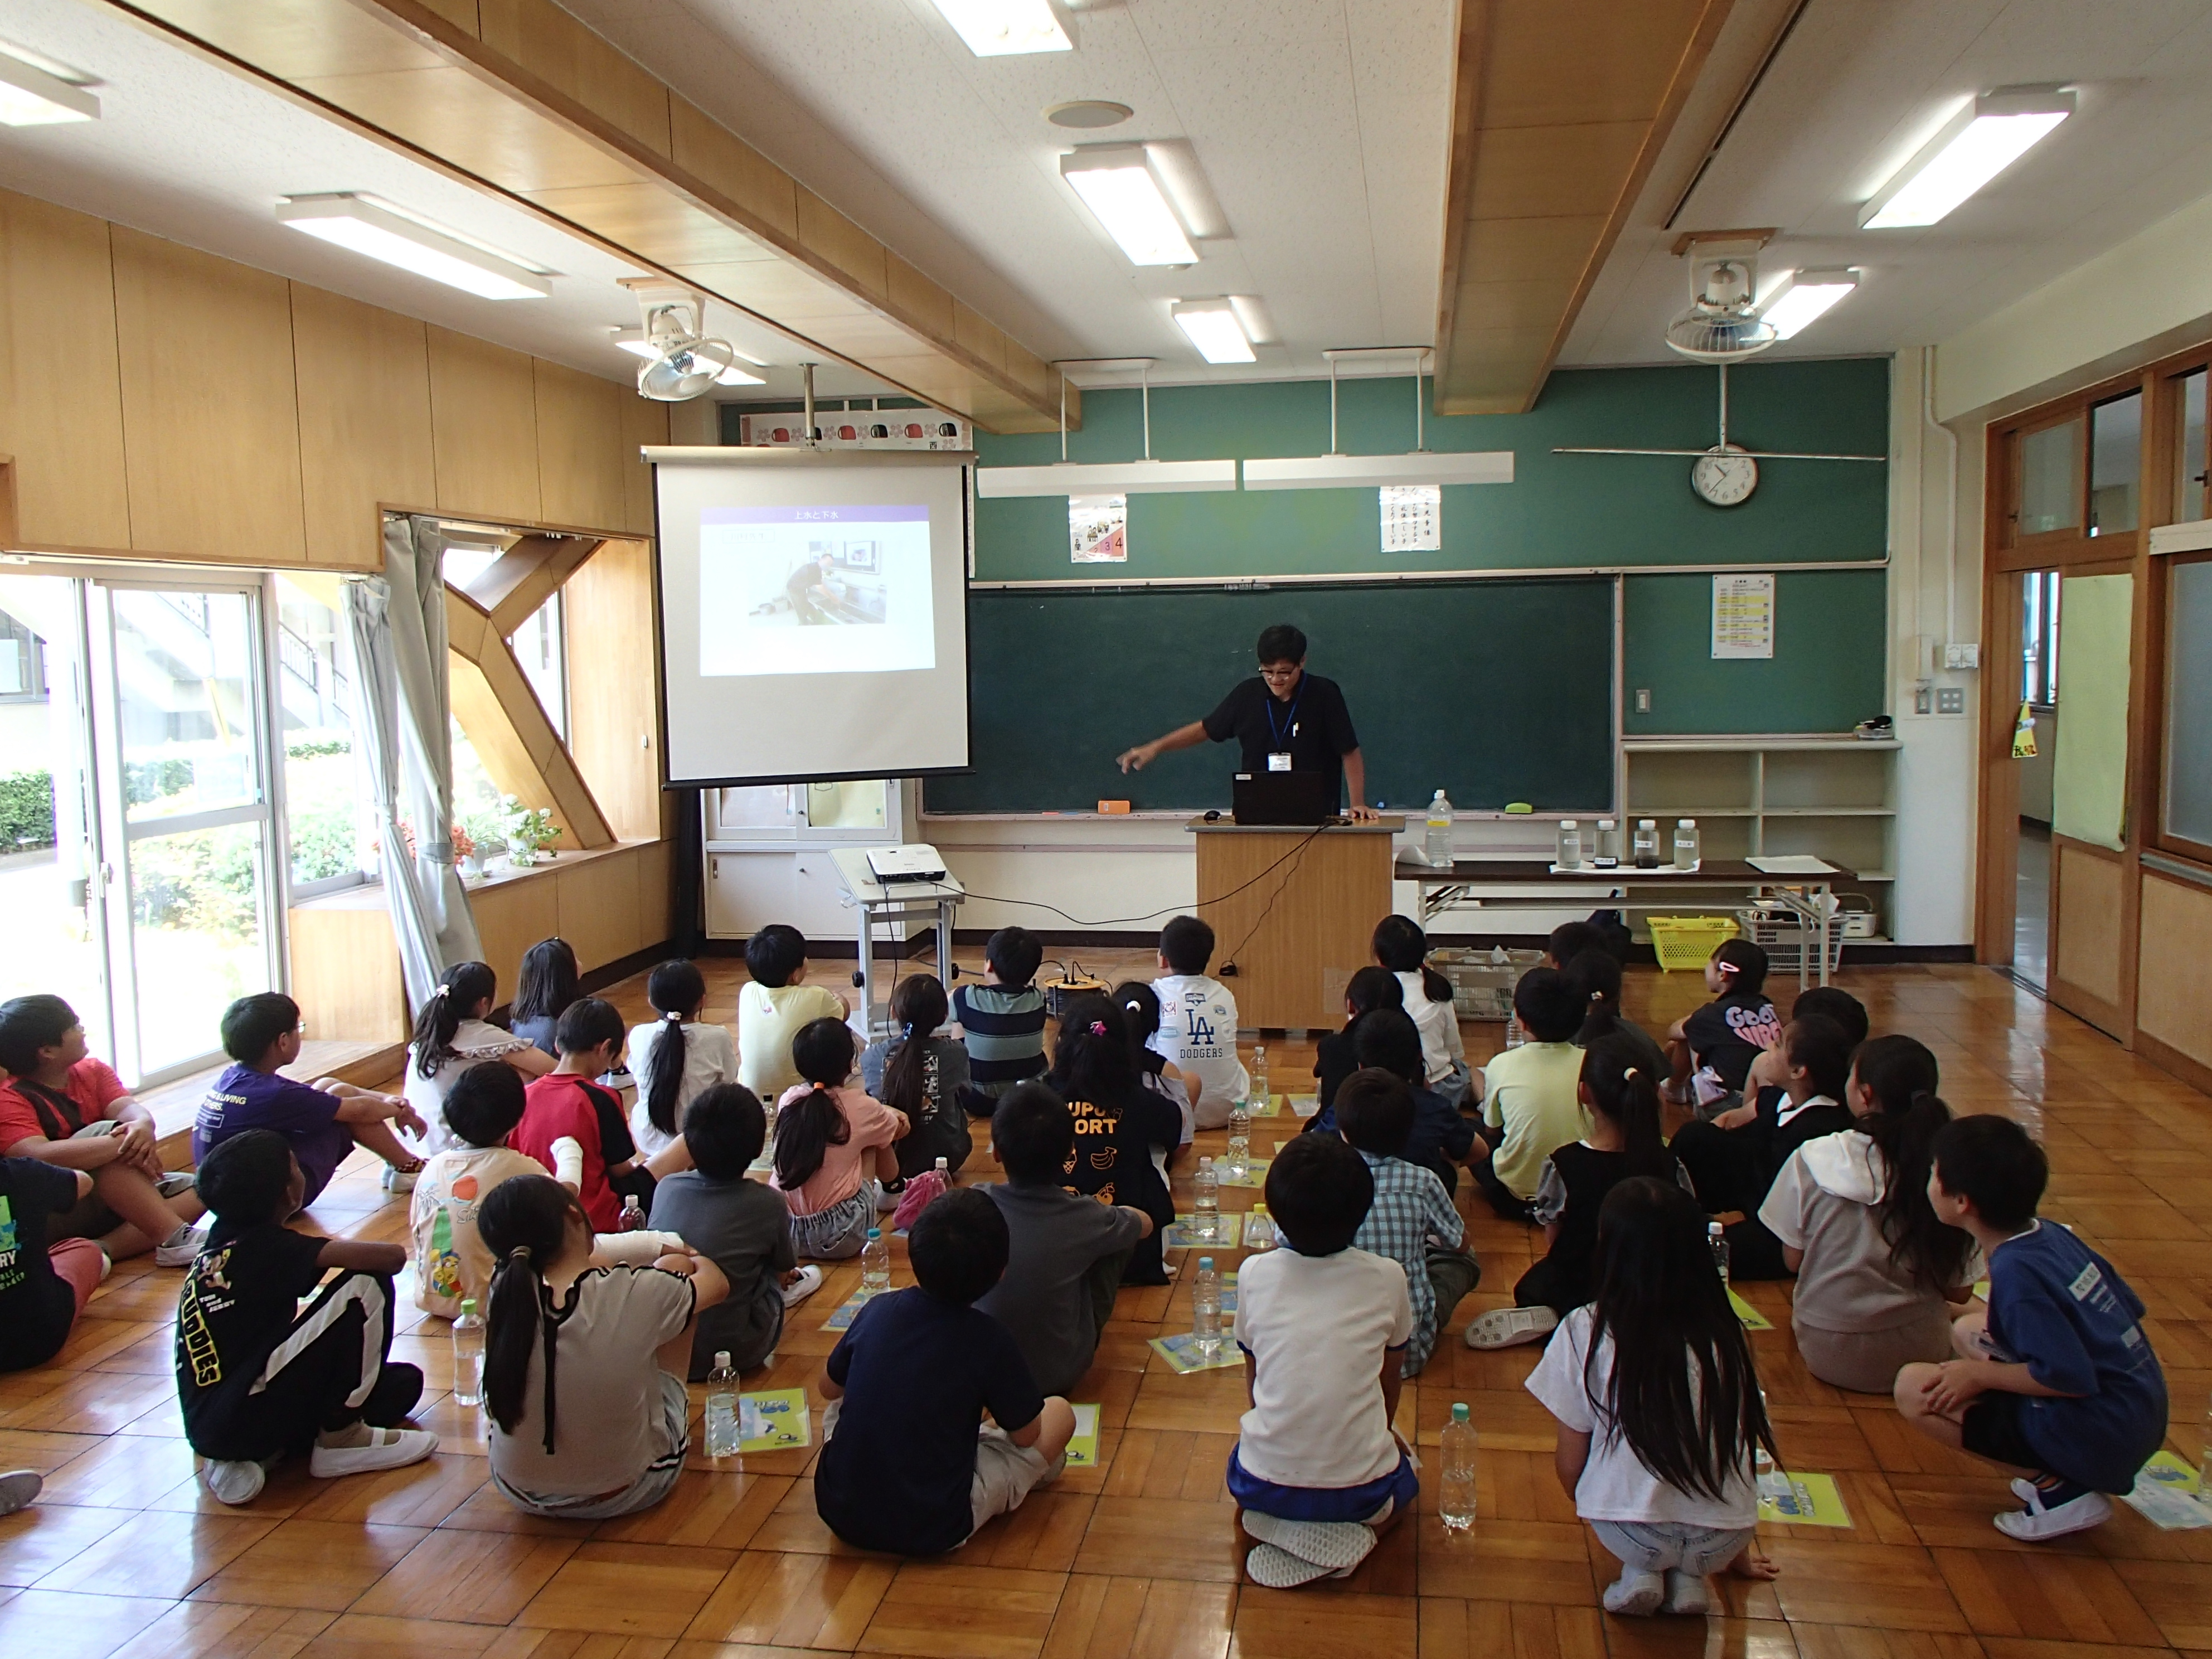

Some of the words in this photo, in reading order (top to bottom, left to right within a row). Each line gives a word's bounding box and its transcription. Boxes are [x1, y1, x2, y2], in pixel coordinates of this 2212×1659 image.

[794, 510, 839, 520] 上水と下水
[1105, 542, 1110, 551] 3
[1115, 537, 1123, 549] 4
[1185, 1009, 1214, 1045] LA
[1180, 1048, 1223, 1059] DODGERS
